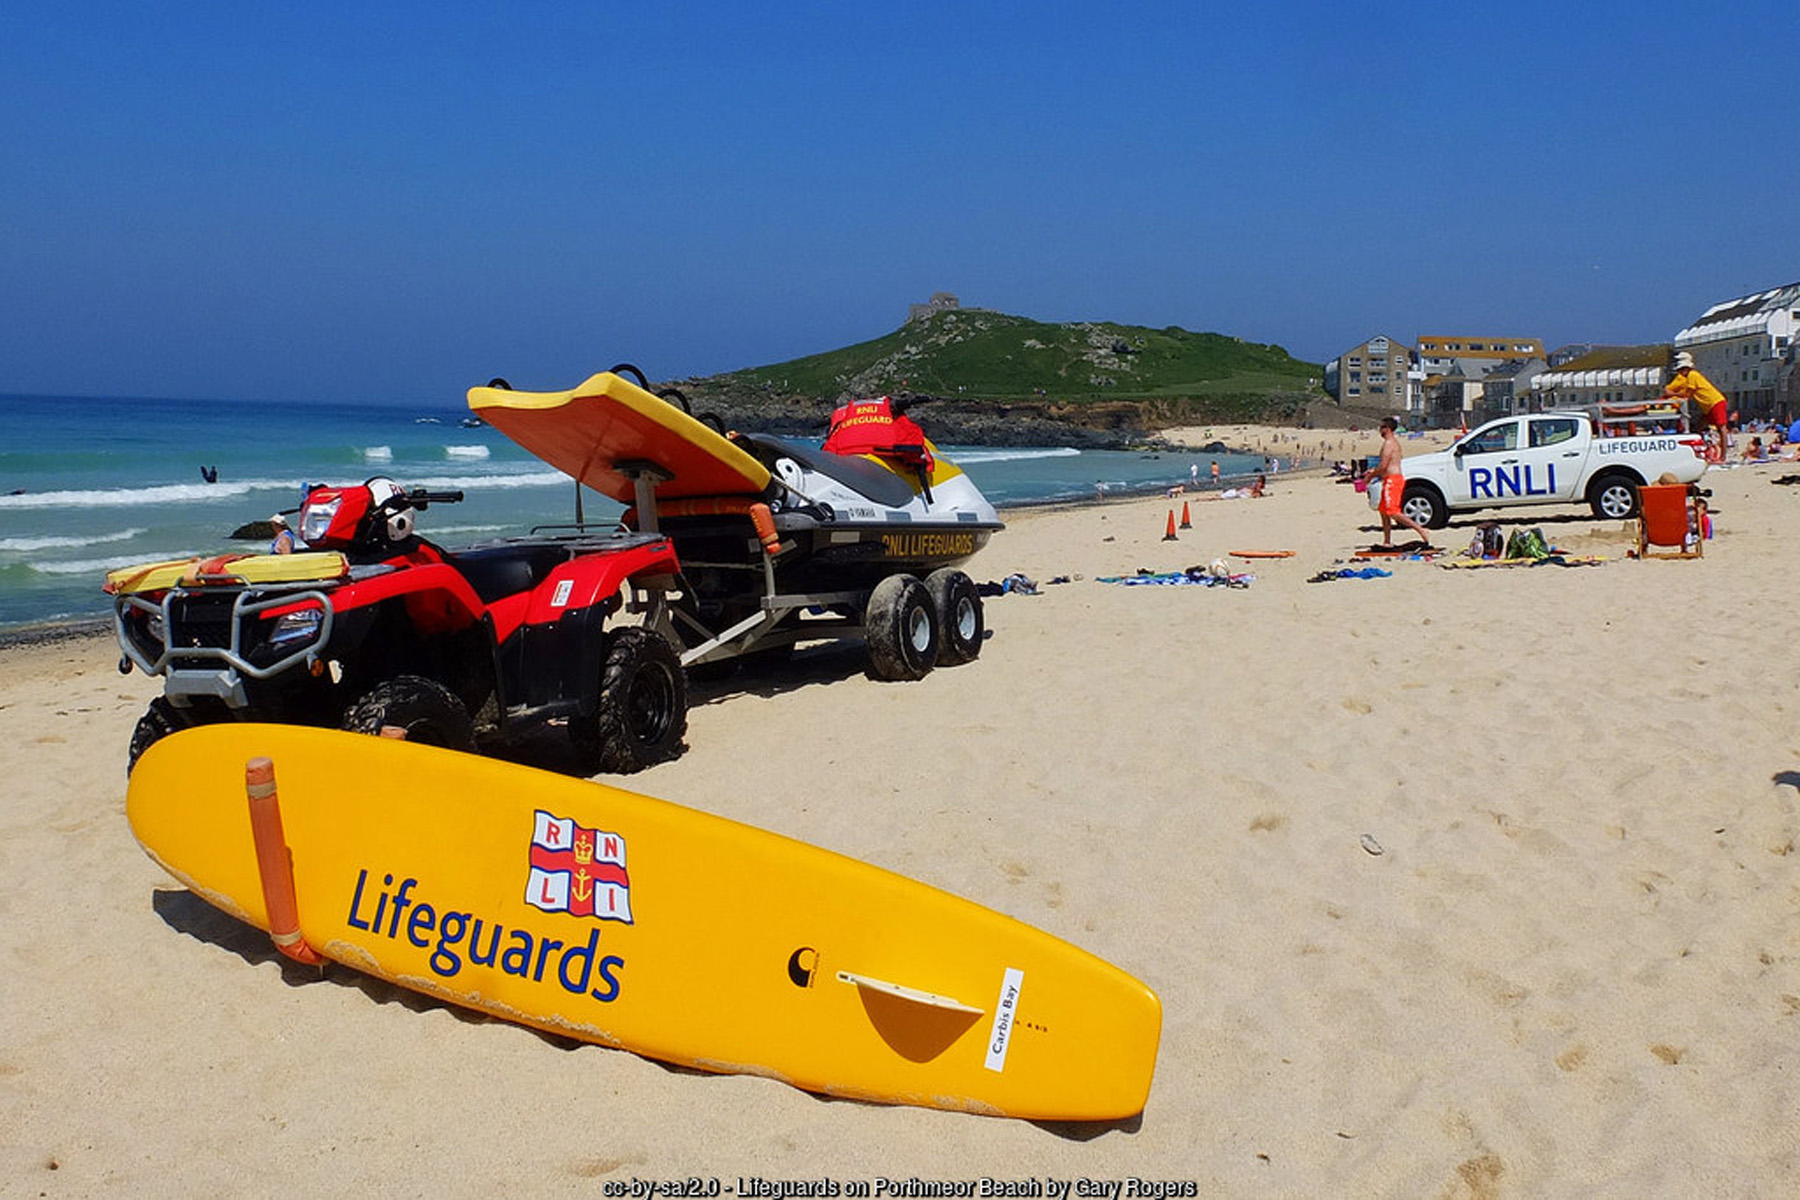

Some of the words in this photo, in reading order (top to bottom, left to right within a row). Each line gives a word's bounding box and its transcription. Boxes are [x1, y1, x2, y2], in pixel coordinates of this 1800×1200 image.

[856, 406, 878, 415] RNLI
[1599, 439, 1677, 455] LIFEGUARD
[1469, 463, 1556, 499] RNLI
[911, 534, 973, 556] LIFEGUARDS
[347, 869, 626, 1002] Lifeguards
[992, 1012, 1010, 1054] Carbis
[1002, 985, 1019, 1009] Bay
